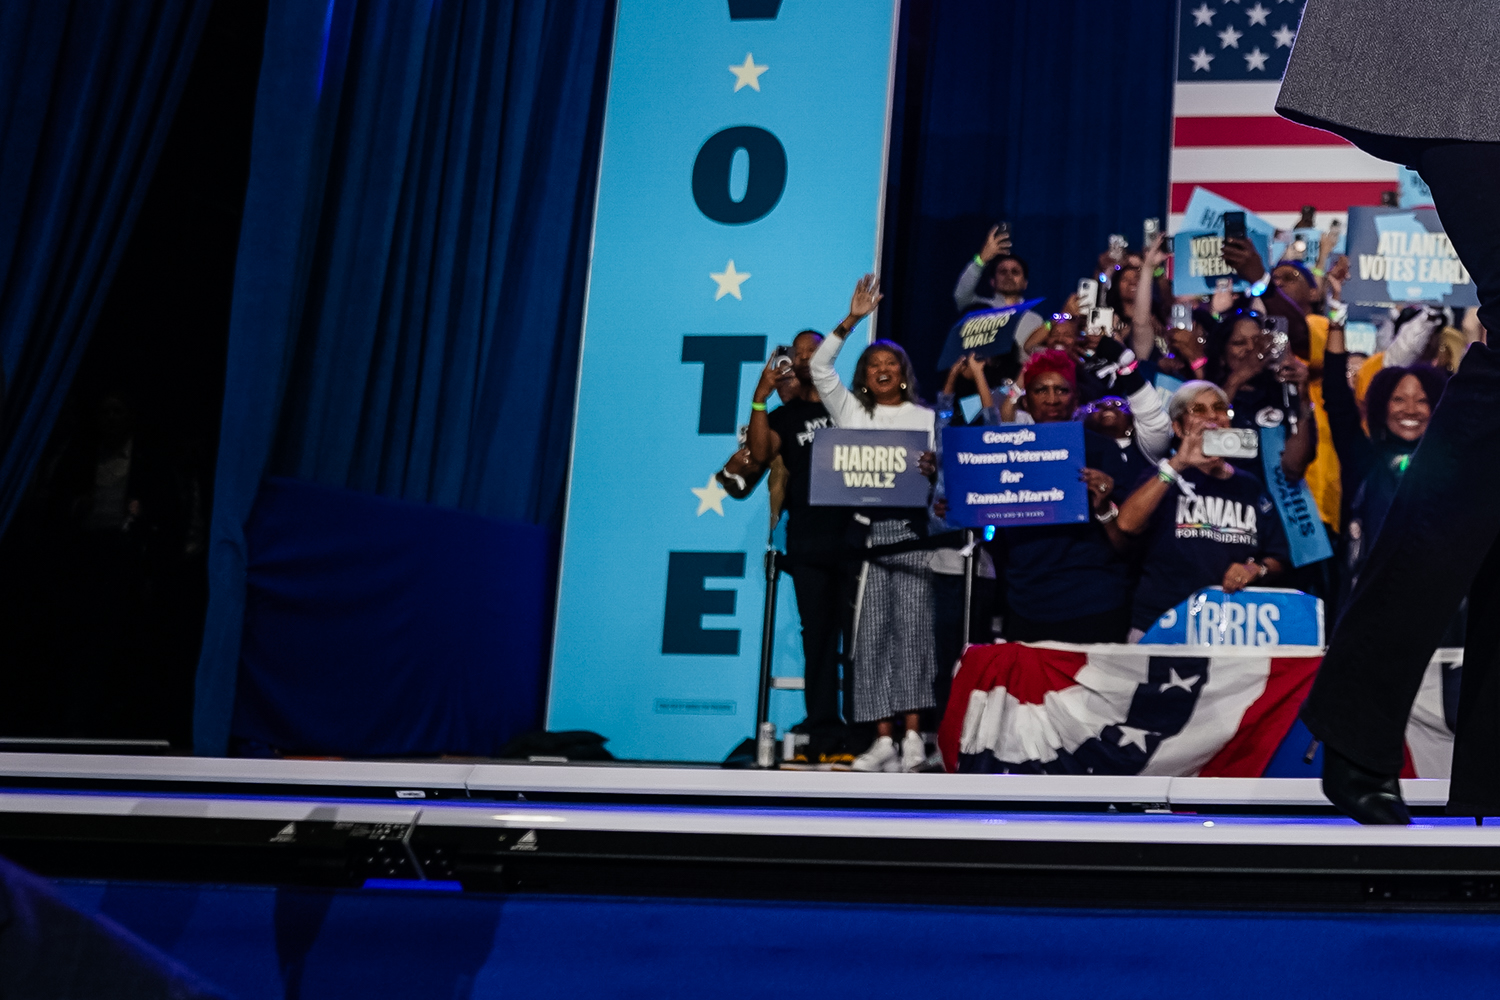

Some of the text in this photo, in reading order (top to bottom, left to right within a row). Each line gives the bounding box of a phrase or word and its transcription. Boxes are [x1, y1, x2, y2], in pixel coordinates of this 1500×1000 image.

[1359, 254, 1416, 282] VOTES
[963, 329, 998, 349] WALZ
[982, 428, 1036, 445] Georgia
[833, 444, 907, 473] HARRIS
[957, 449, 1069, 465] Women Veterans
[843, 471, 896, 488] WALZ
[1000, 469, 1024, 484] for
[966, 487, 1065, 505] Kamala Harris
[1175, 494, 1258, 534] KAMALA
[1175, 528, 1198, 539] FOR
